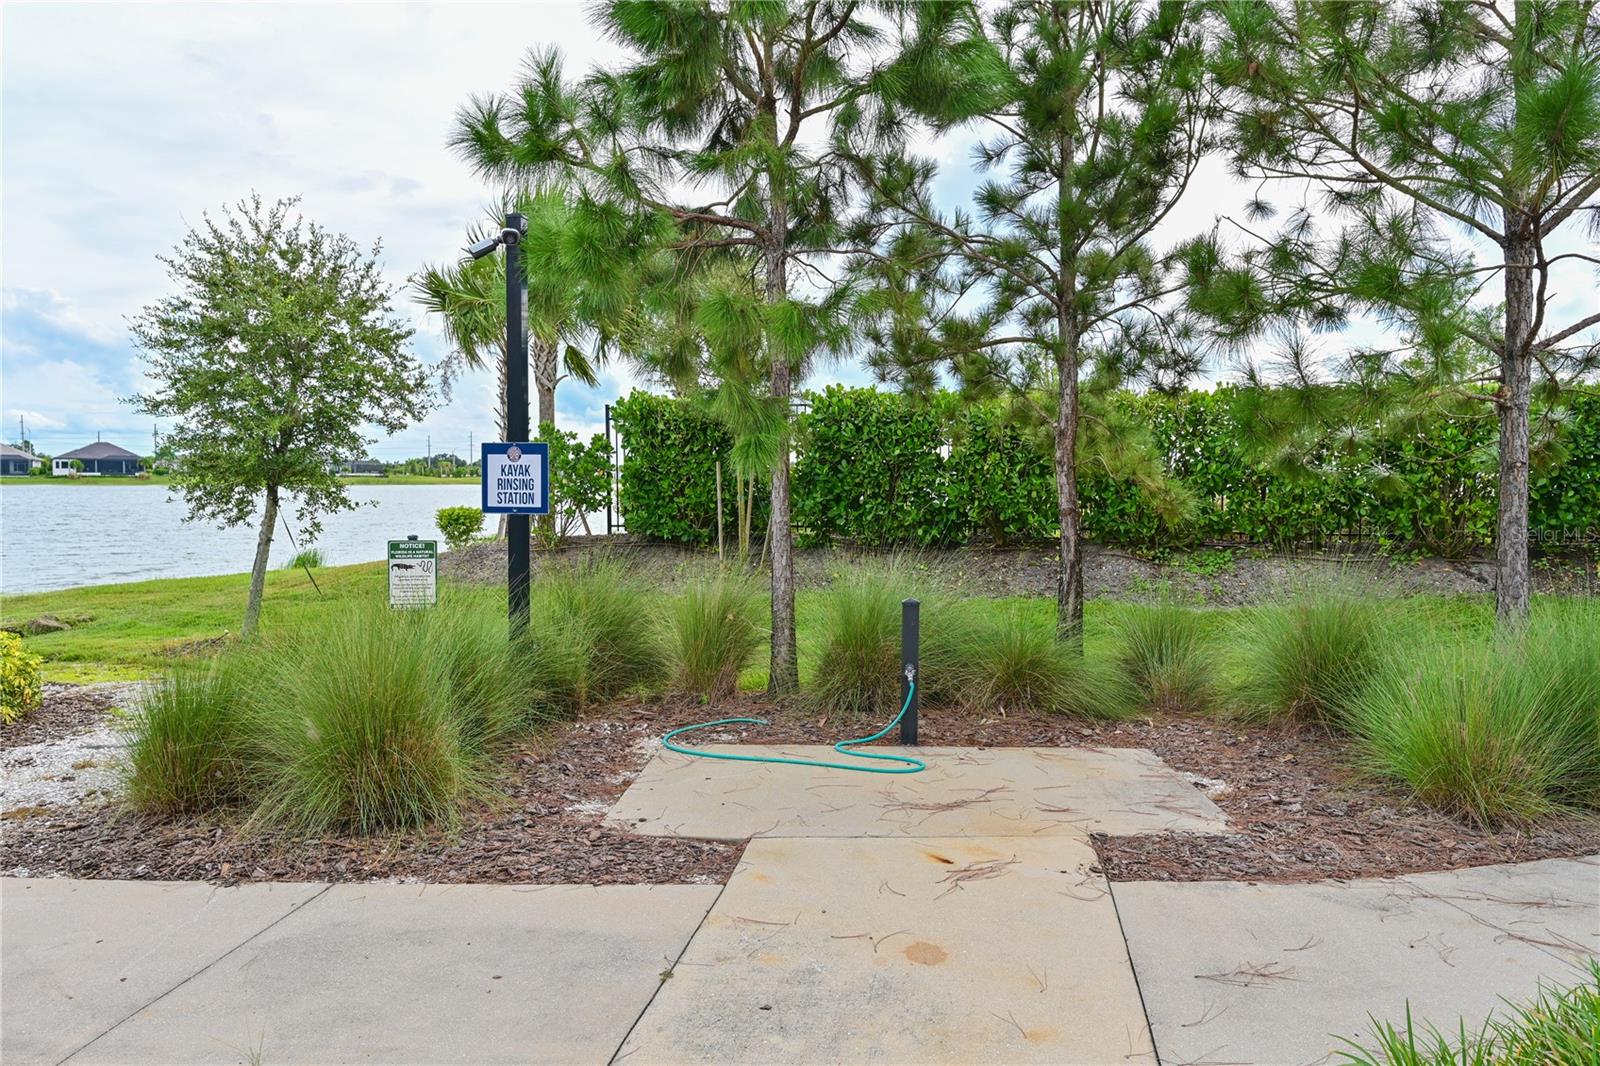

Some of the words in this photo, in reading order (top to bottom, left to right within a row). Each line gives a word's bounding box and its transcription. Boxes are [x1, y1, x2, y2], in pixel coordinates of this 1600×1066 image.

[500, 464, 531, 477] KAYAK
[497, 478, 534, 490] RINSING
[496, 492, 534, 504] STATION
